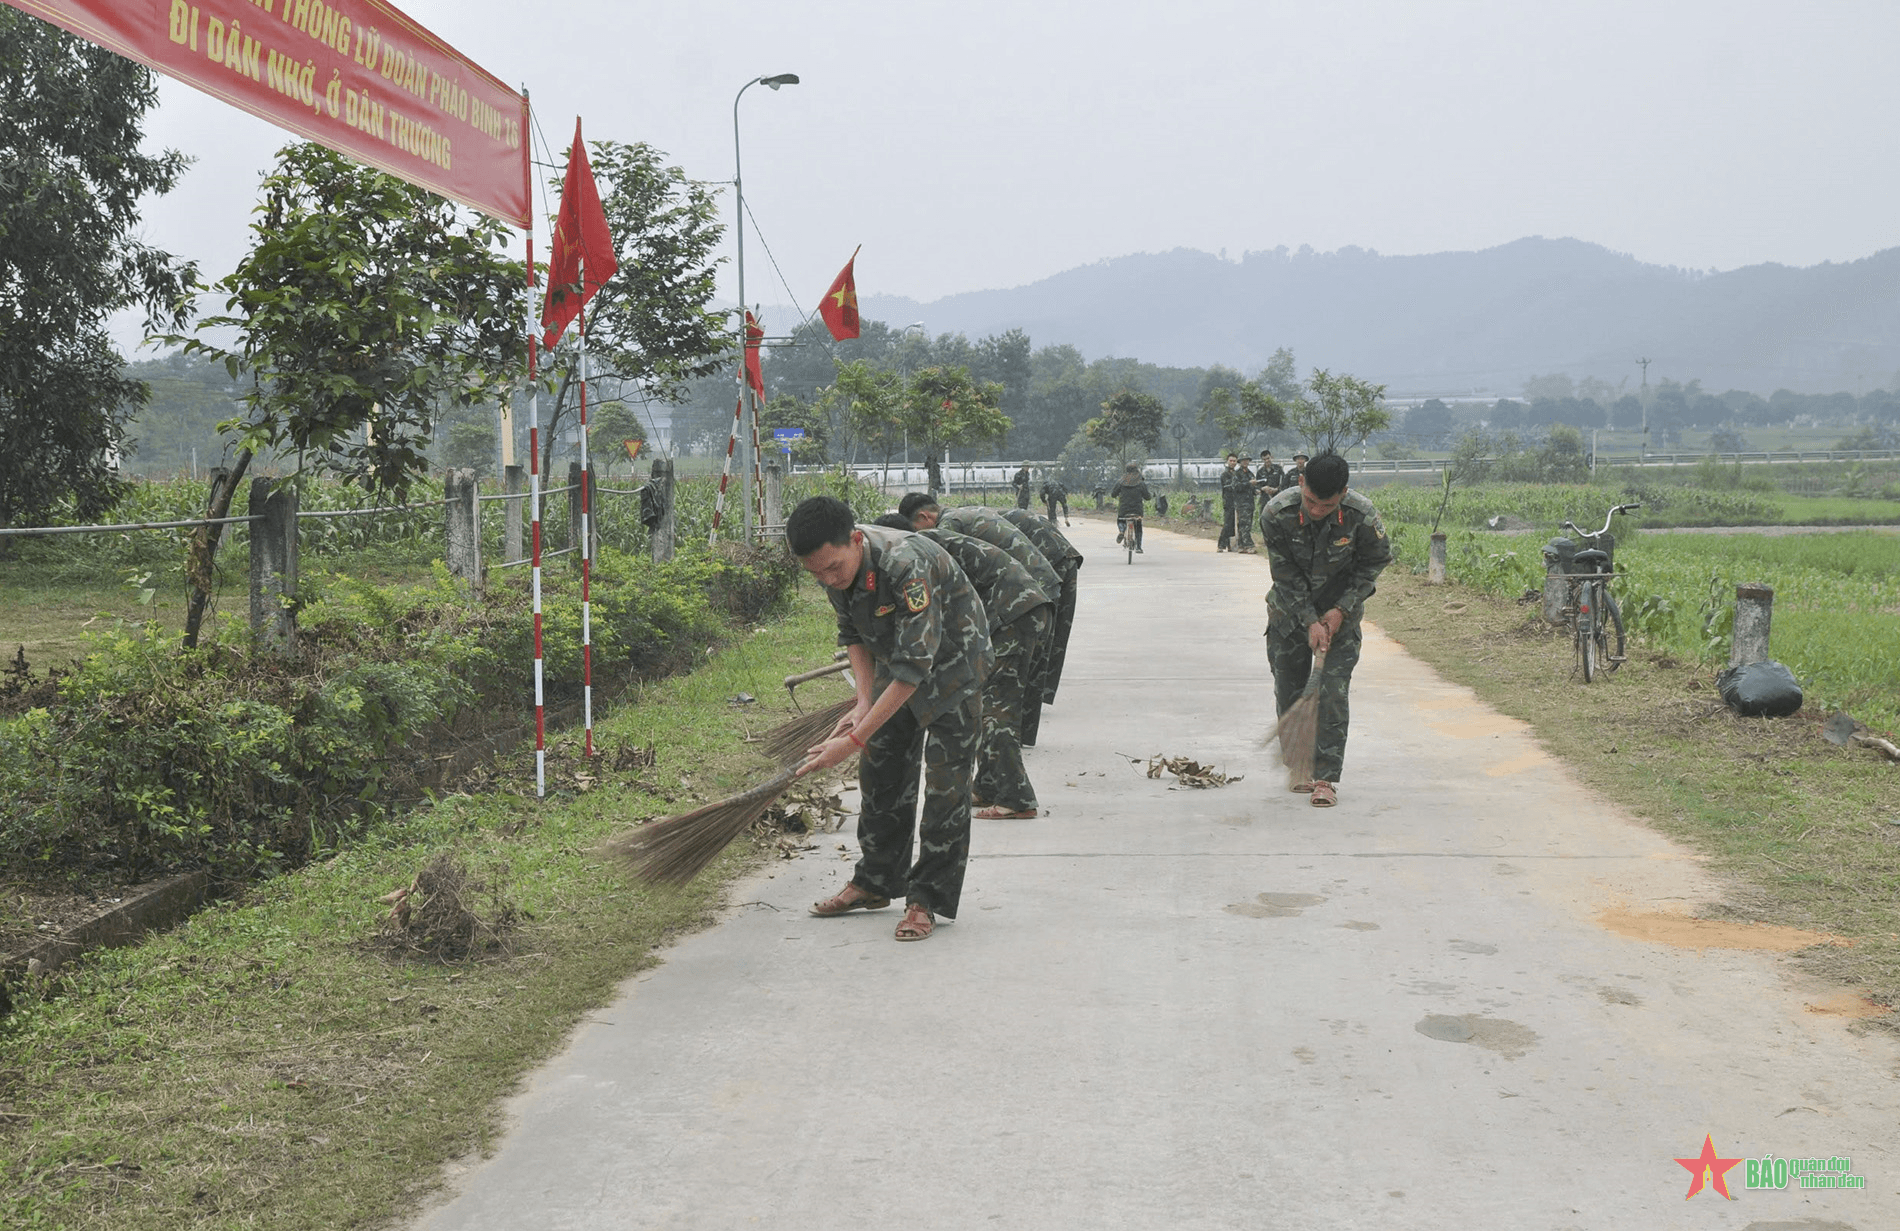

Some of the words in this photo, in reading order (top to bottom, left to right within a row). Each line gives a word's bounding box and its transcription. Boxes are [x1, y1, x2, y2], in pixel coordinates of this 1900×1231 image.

[169, 0, 199, 51] ĐI
[207, 15, 261, 82] DÂN
[267, 49, 320, 115] NHỚ,
[326, 68, 341, 118] Ở
[346, 88, 384, 140] DÂN
[390, 110, 451, 170] THƯƠNG
[354, 26, 381, 71] LỮ
[381, 43, 428, 99] ĐOÀN
[430, 72, 468, 121] PHÁO
[471, 96, 500, 141] BINH
[504, 117, 519, 149] 16
